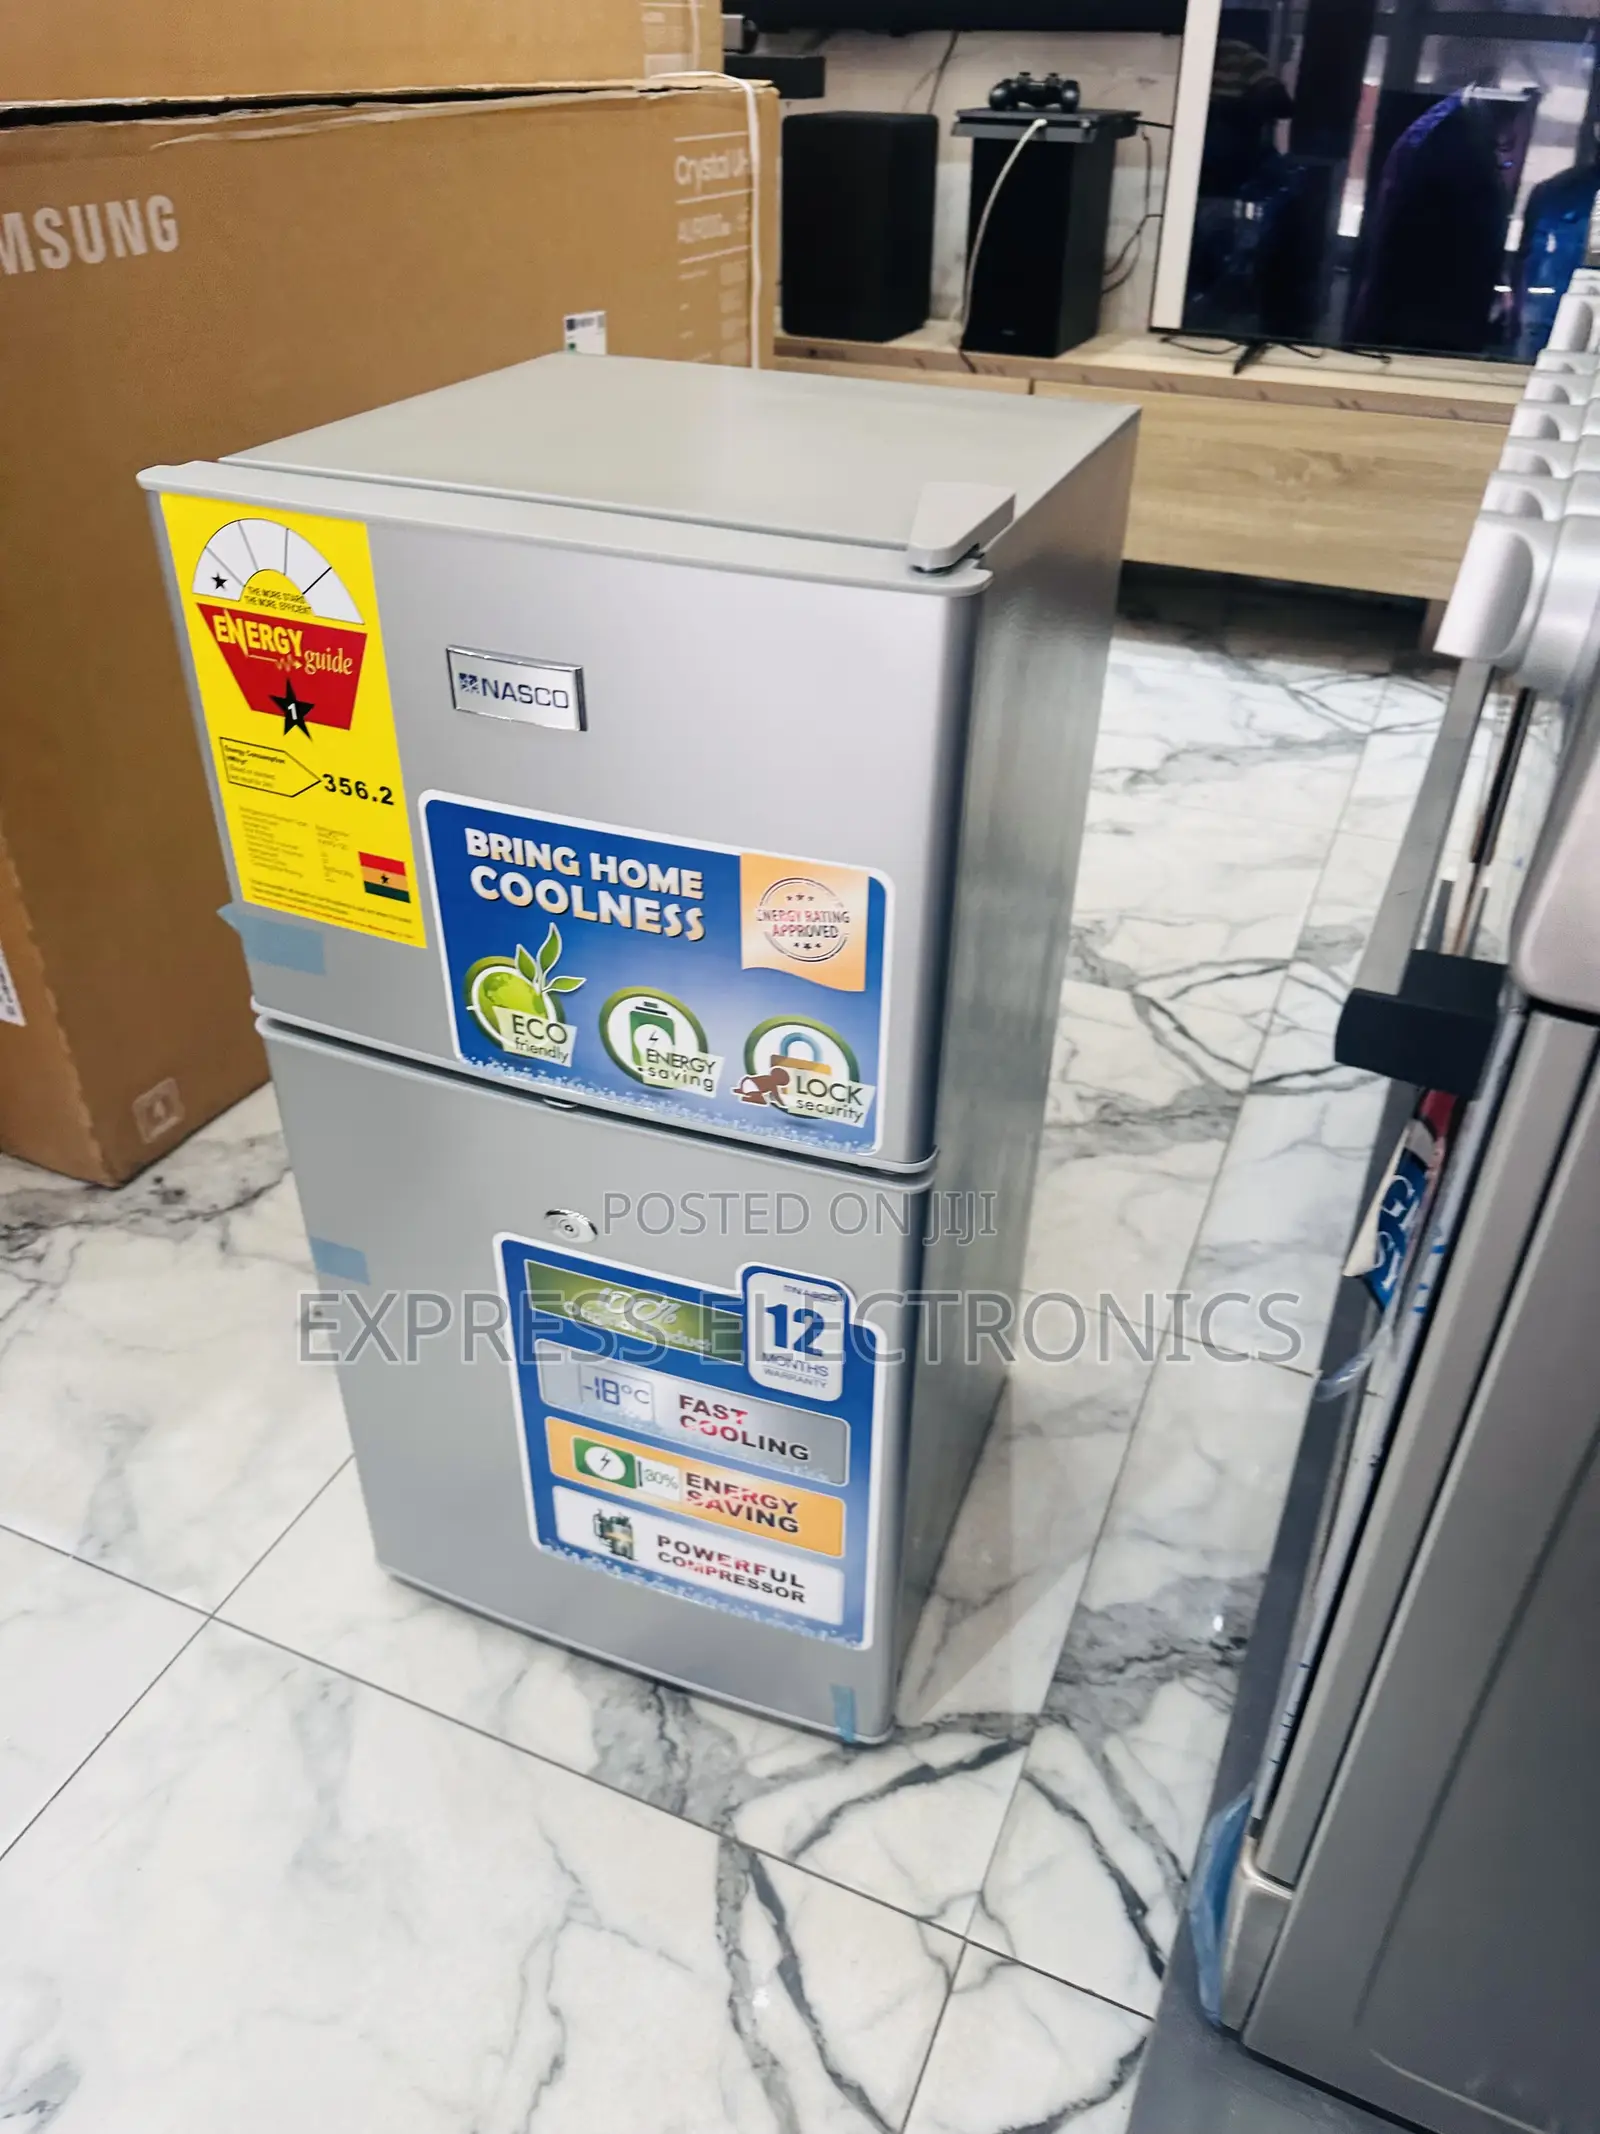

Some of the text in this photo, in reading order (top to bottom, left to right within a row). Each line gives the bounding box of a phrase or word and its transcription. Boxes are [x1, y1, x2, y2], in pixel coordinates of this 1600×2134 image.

[212, 608, 303, 658] ENERGY
[303, 648, 353, 675] guide
[481, 677, 569, 709] NASCO
[287, 702, 298, 721] 1
[321, 773, 394, 806] 356.2
[464, 826, 704, 900] BRING HOME
[470, 864, 706, 942] COOLNESS
[804, 910, 850, 924] RATING
[772, 924, 839, 939] APPROVED
[511, 1013, 568, 1045] ECO
[514, 1036, 570, 1064] friendly
[645, 1048, 717, 1076] ENERGY
[648, 1066, 715, 1092] saving
[796, 1075, 864, 1106] LOCK
[795, 1099, 865, 1124] security
[764, 1303, 825, 1357] 12
[762, 1352, 829, 1377] MONTHS
[763, 1367, 828, 1388] WARRANTY
[679, 1394, 748, 1425] FAST
[680, 1414, 809, 1461] COOLING
[644, 1468, 679, 1490] 30%
[686, 1472, 799, 1515] ENERGY
[686, 1489, 799, 1534] SAVING
[657, 1534, 806, 1589] POWERFUL
[657, 1551, 806, 1603] COMPRESSOR
